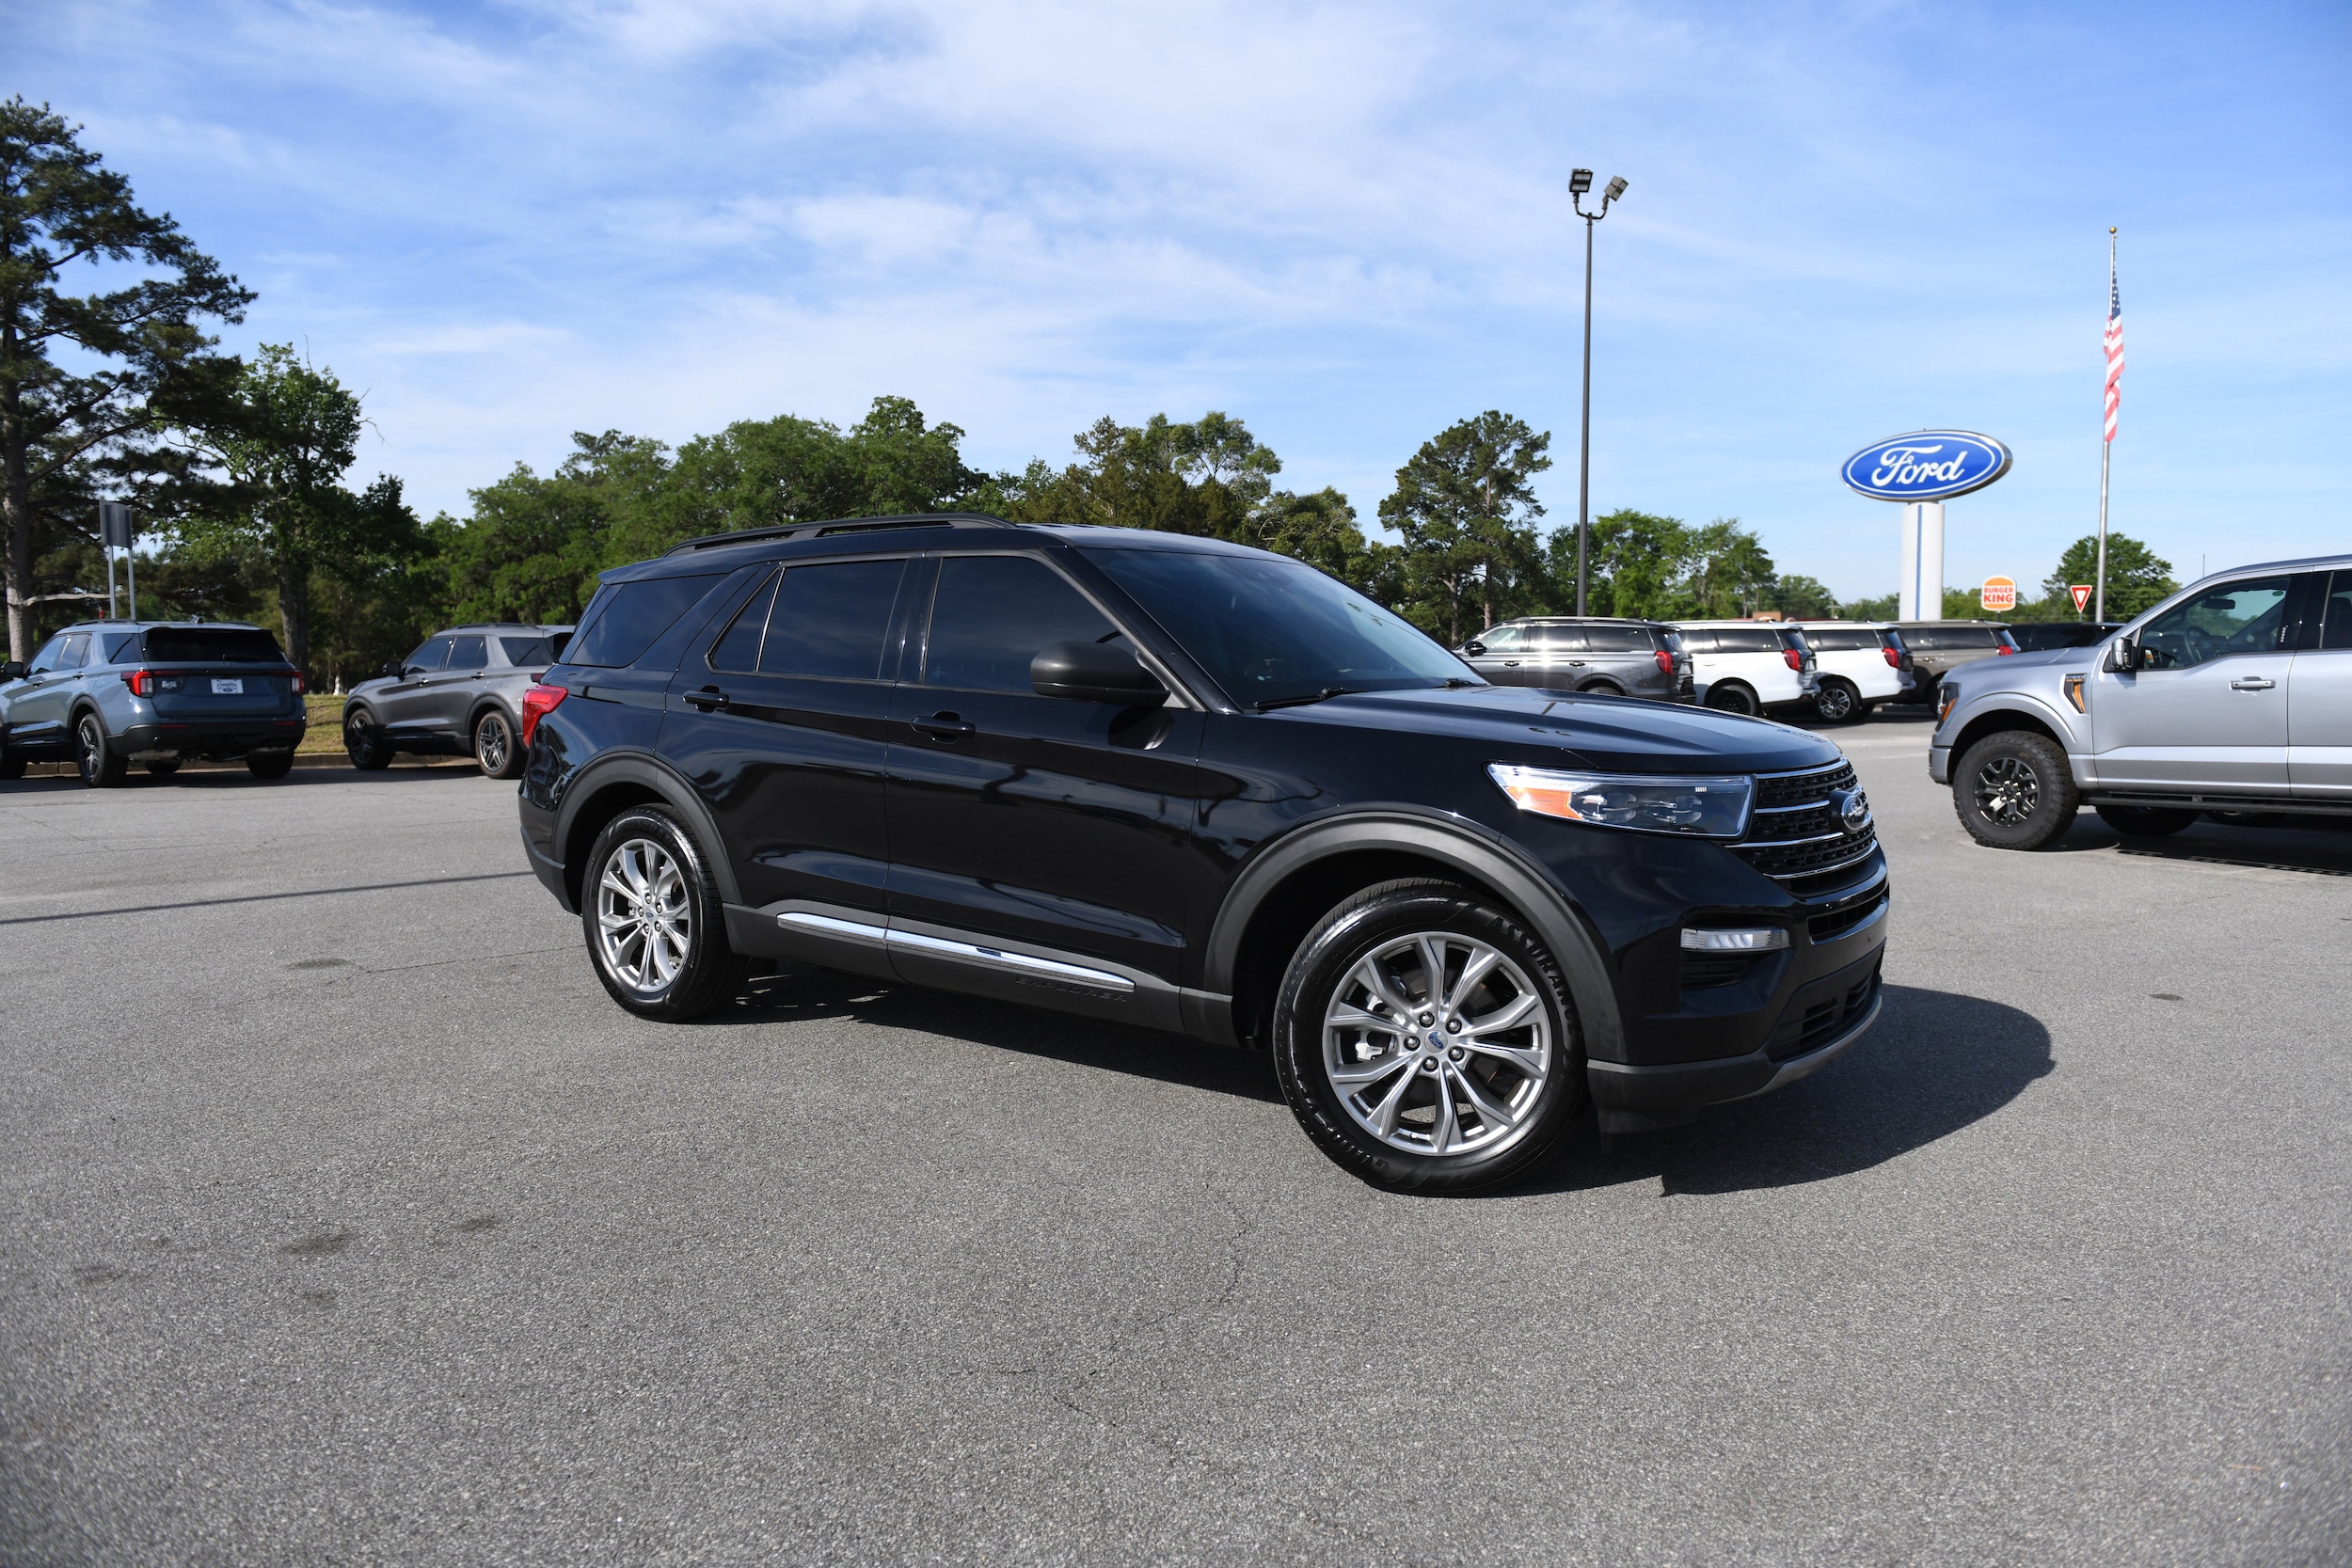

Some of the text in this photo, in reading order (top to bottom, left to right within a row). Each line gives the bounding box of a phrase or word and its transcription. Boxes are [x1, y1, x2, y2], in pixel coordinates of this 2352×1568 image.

[1871, 444, 1968, 486] Ford
[1983, 594, 2013, 603] KING
[1015, 976, 1127, 1003] EXPLORER
